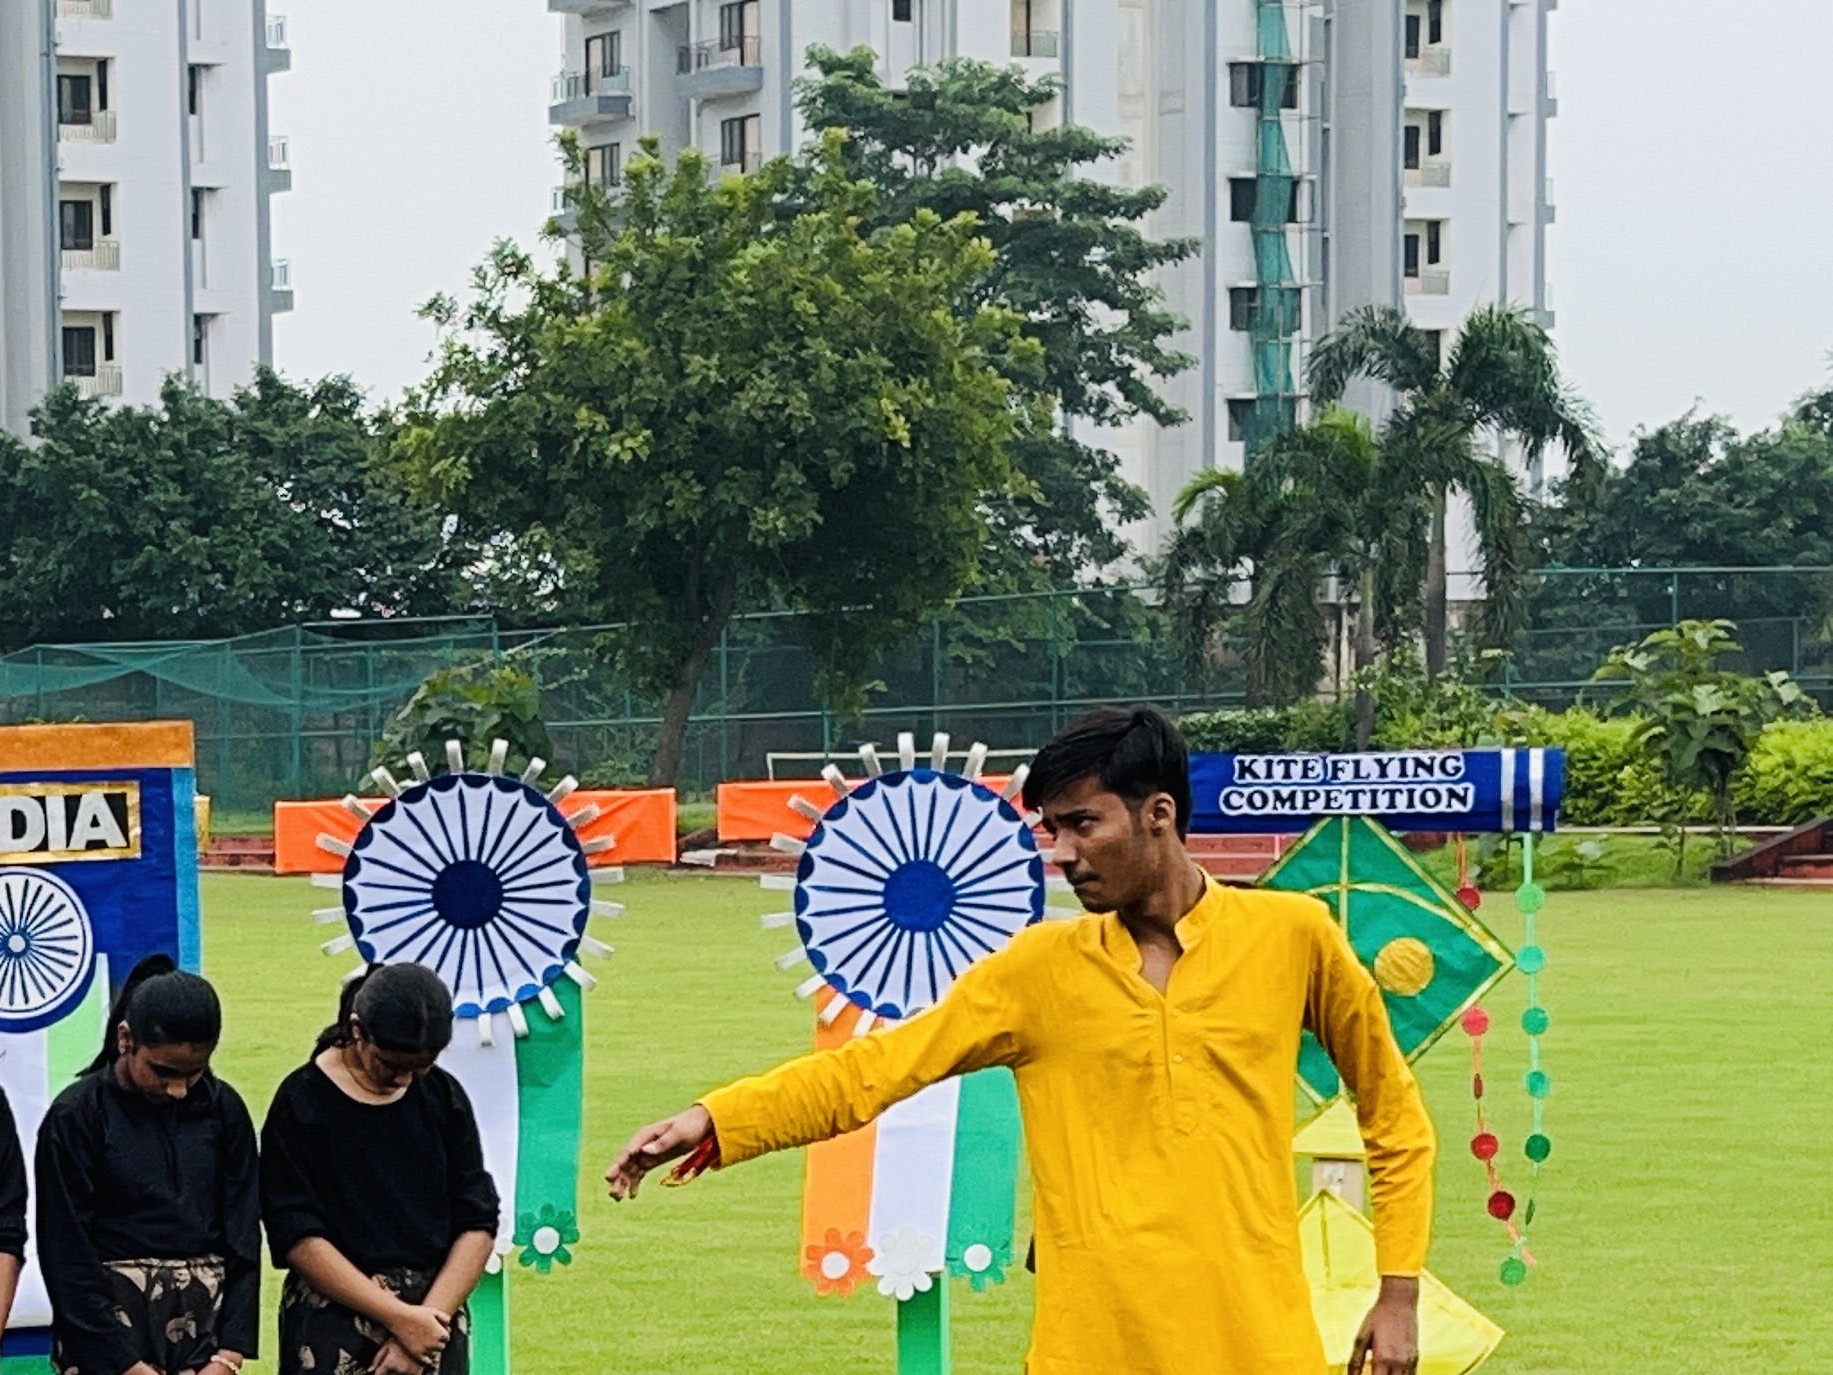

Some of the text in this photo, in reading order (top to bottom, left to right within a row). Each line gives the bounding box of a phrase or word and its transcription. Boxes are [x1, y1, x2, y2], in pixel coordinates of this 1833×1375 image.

[1236, 756, 1462, 781] KITE FLYING
[1222, 787, 1469, 811] COMPETITION
